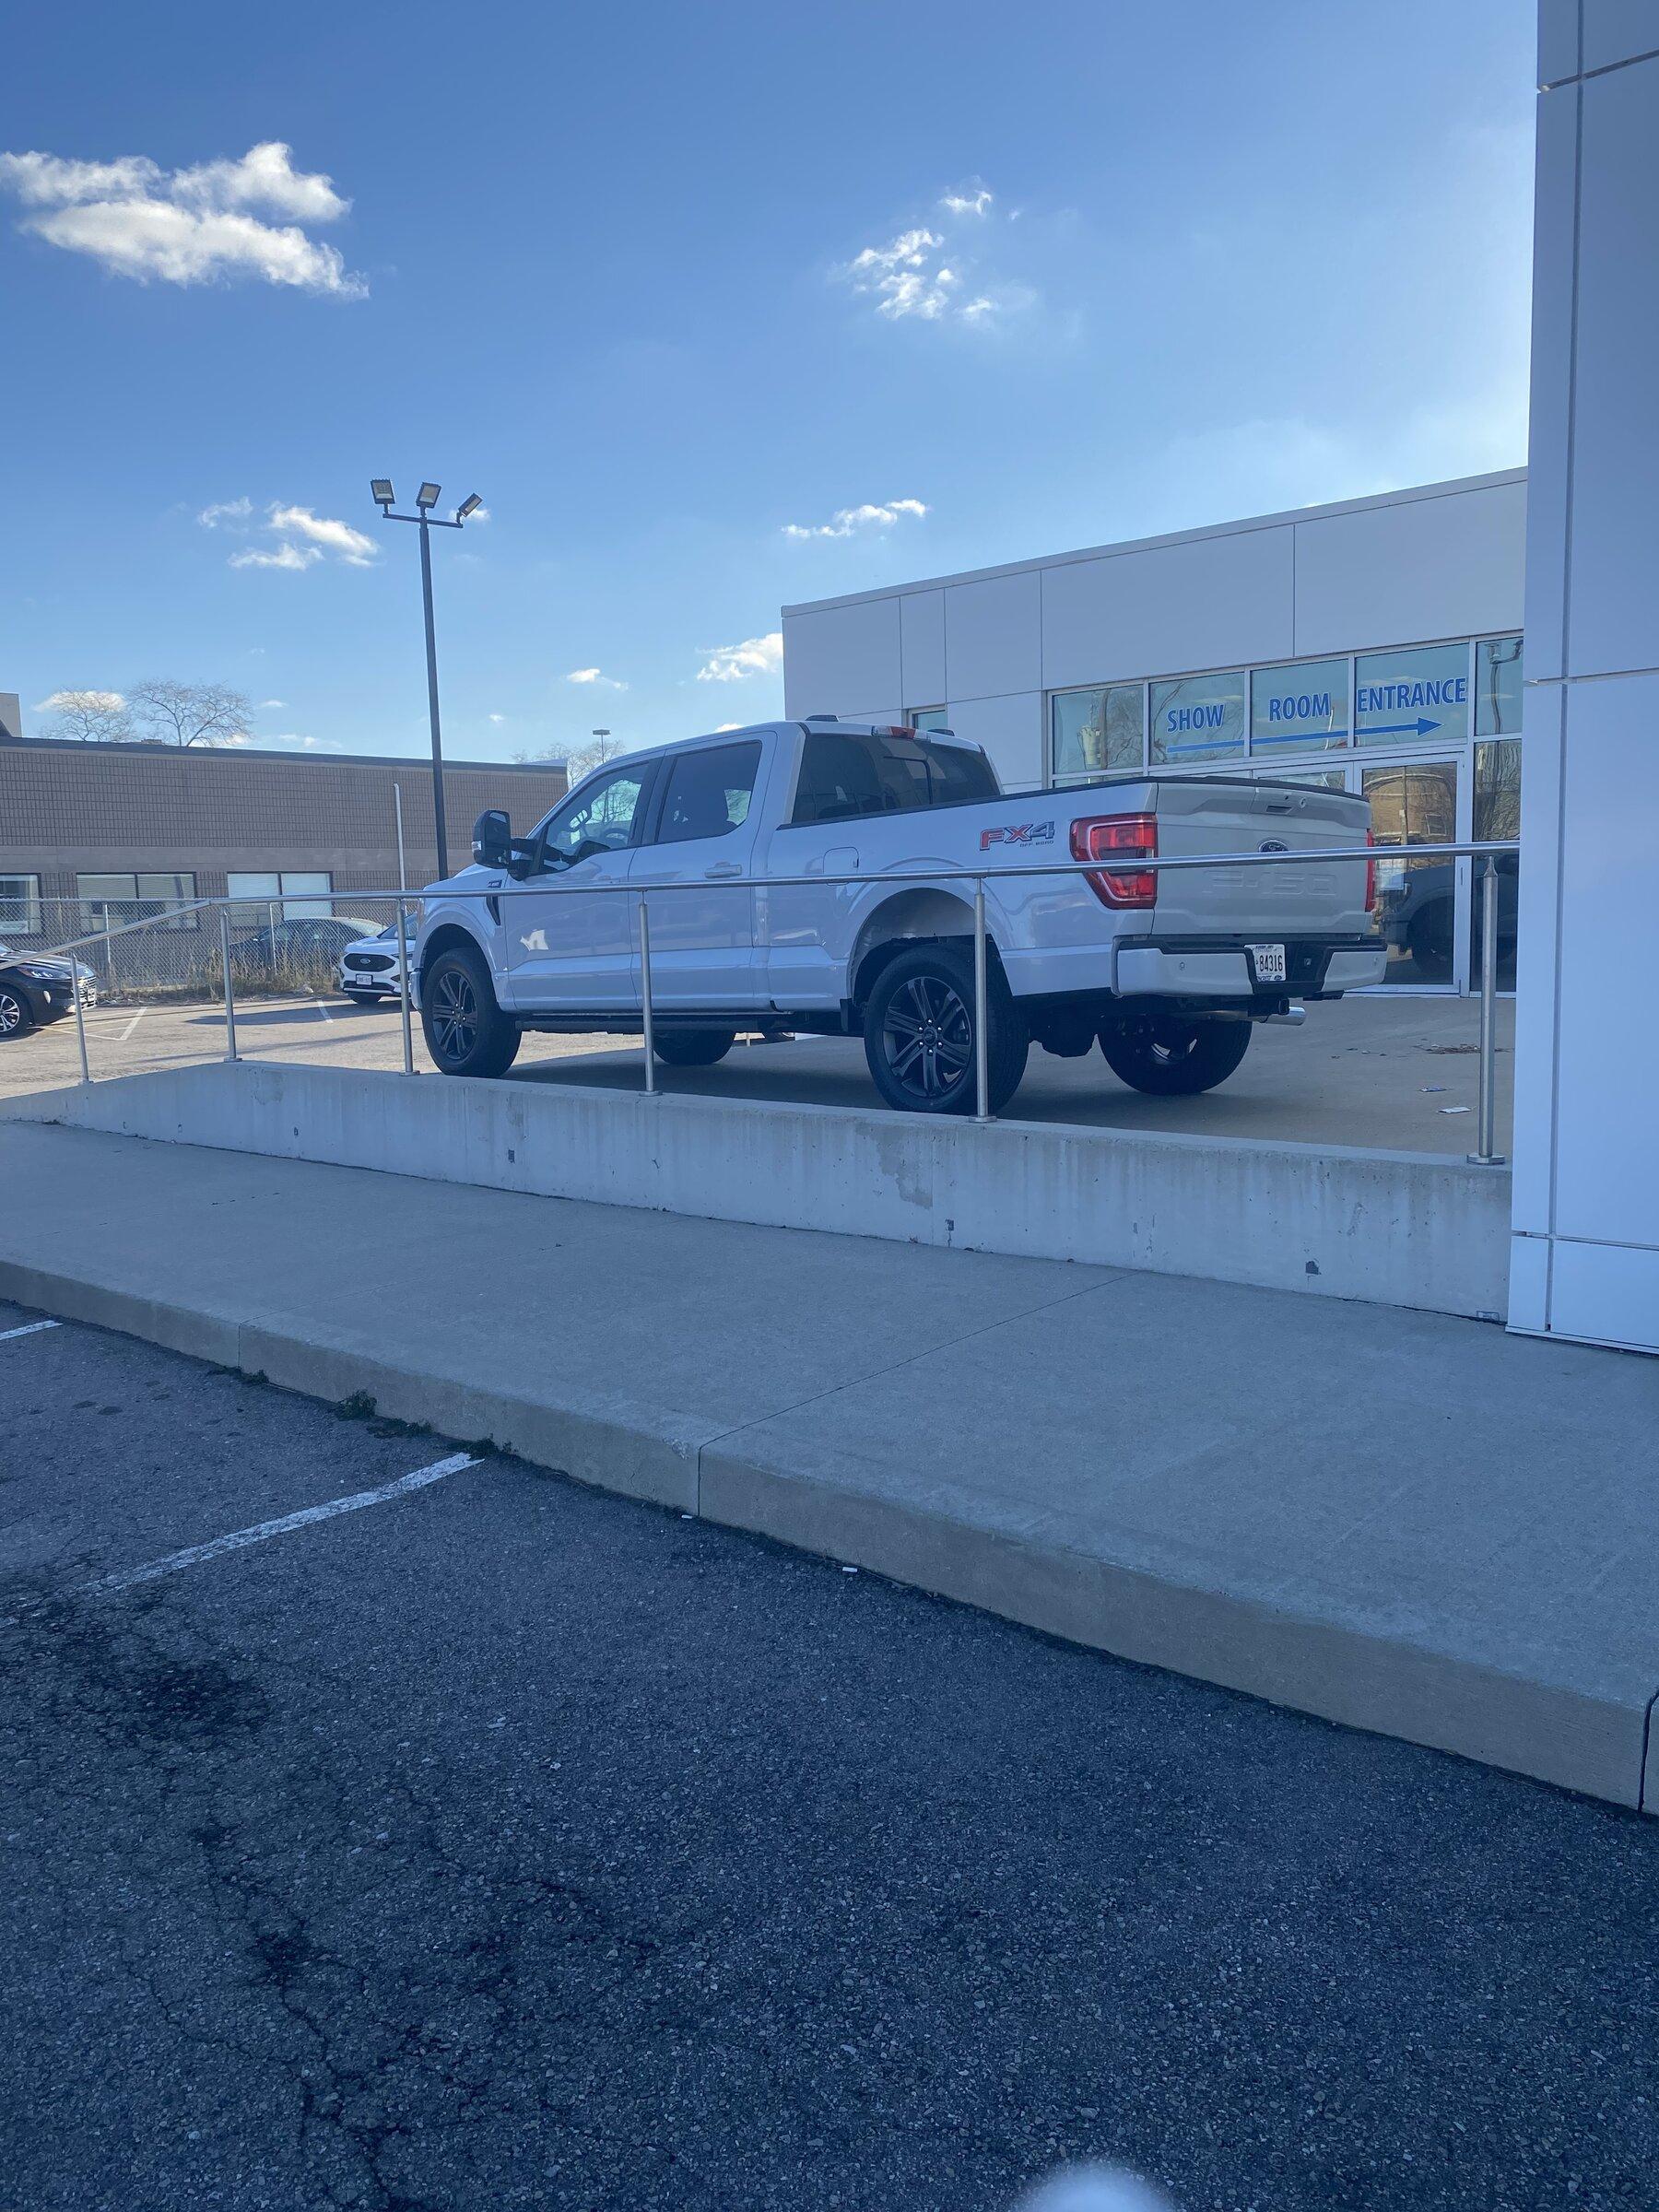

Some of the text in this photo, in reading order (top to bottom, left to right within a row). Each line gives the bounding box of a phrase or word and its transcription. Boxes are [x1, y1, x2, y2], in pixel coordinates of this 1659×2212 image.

[1167, 677, 1467, 734] SHOW ROOM ENTRANCE
[980, 821, 1054, 851] FX4
[1259, 955, 1283, 971] 84316
